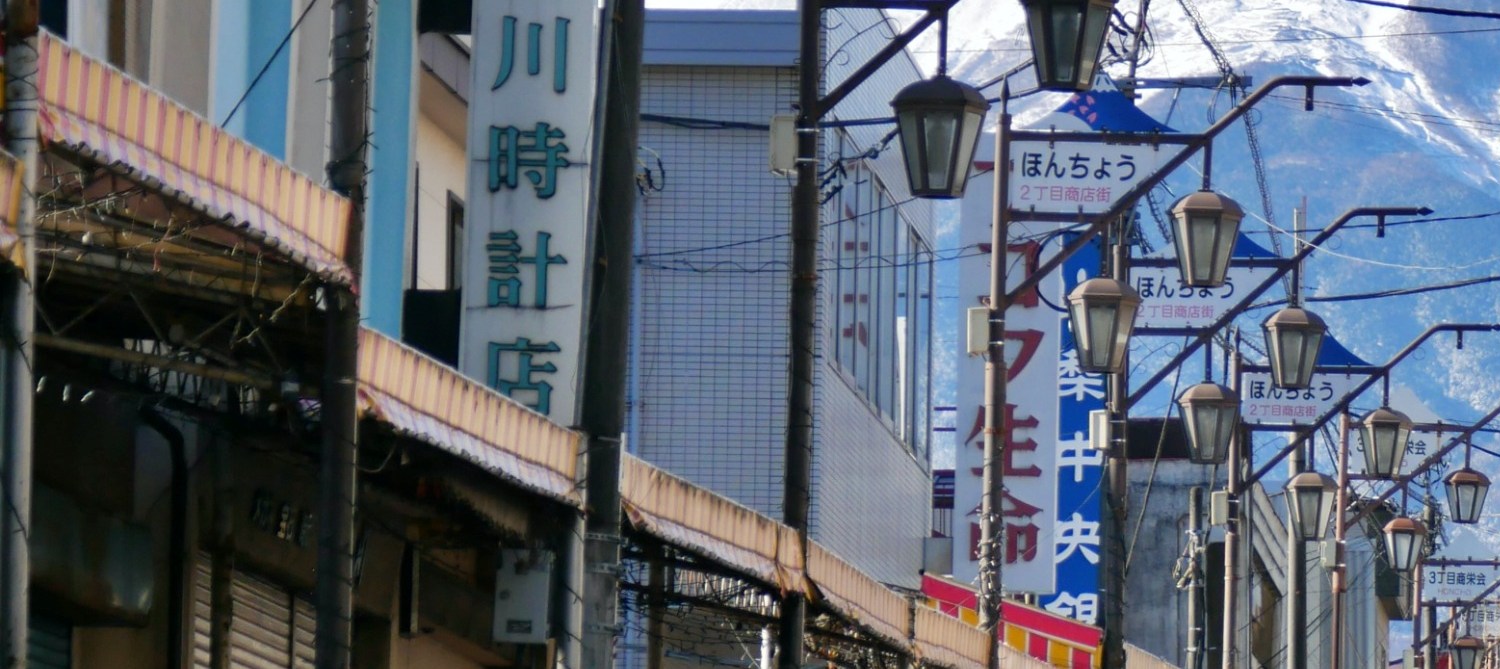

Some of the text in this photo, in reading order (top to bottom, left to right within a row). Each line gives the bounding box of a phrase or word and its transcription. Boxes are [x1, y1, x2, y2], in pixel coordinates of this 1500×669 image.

[1021, 152, 1136, 181] ほんちょう
[1020, 185, 1112, 203] 2丁目商店街
[486, 15, 570, 417] 川時計店
[1250, 404, 1317, 418] 2丁目商店街
